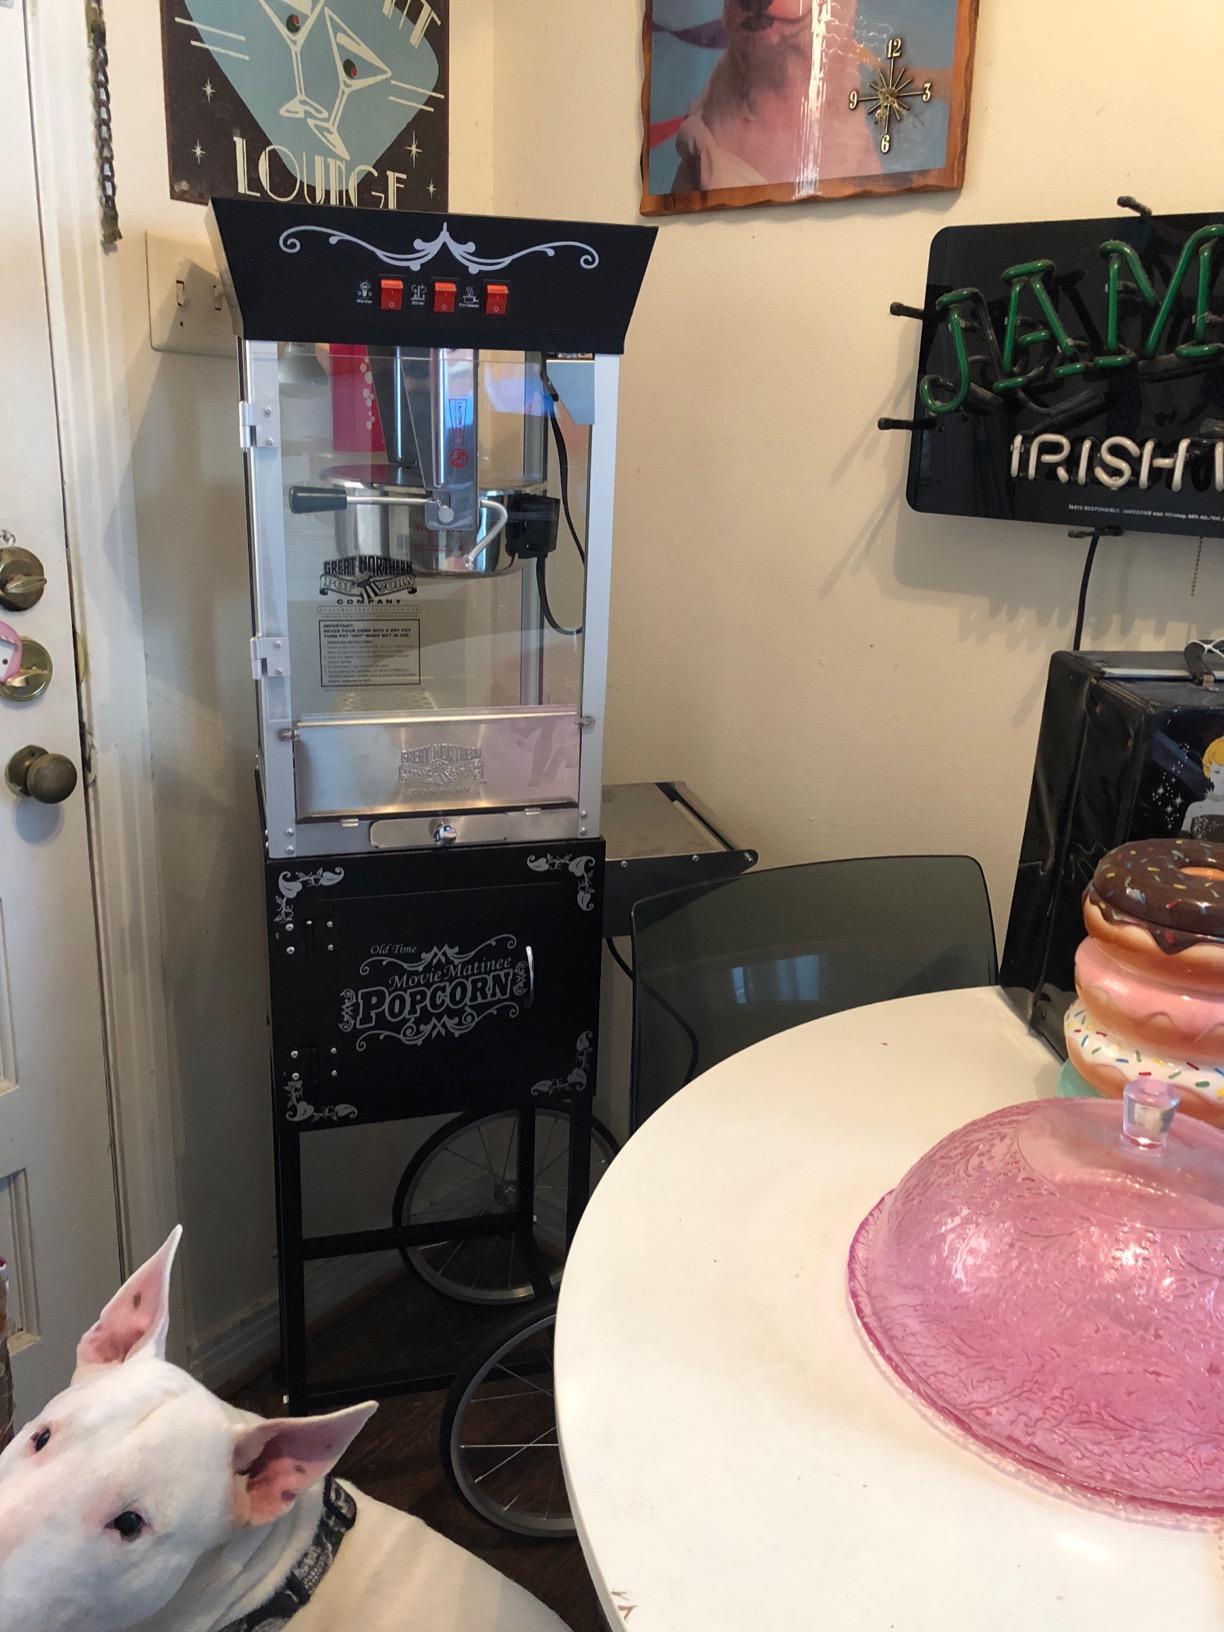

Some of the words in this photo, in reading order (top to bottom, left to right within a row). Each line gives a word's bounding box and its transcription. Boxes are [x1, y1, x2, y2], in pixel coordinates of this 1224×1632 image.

[886, 38, 902, 58] 12
[849, 91, 858, 109] 9
[922, 83, 932, 102] 3
[881, 134, 891, 153] 6
[1010, 433, 1191, 492] IRISH
[324, 557, 357, 576] GREAT
[358, 555, 413, 576] NORTHERN
[370, 943, 391, 955] Old
[392, 943, 417, 954] Time
[388, 970, 442, 991] Movie
[443, 957, 512, 979] Matinee
[356, 968, 513, 1029] POPCORN
